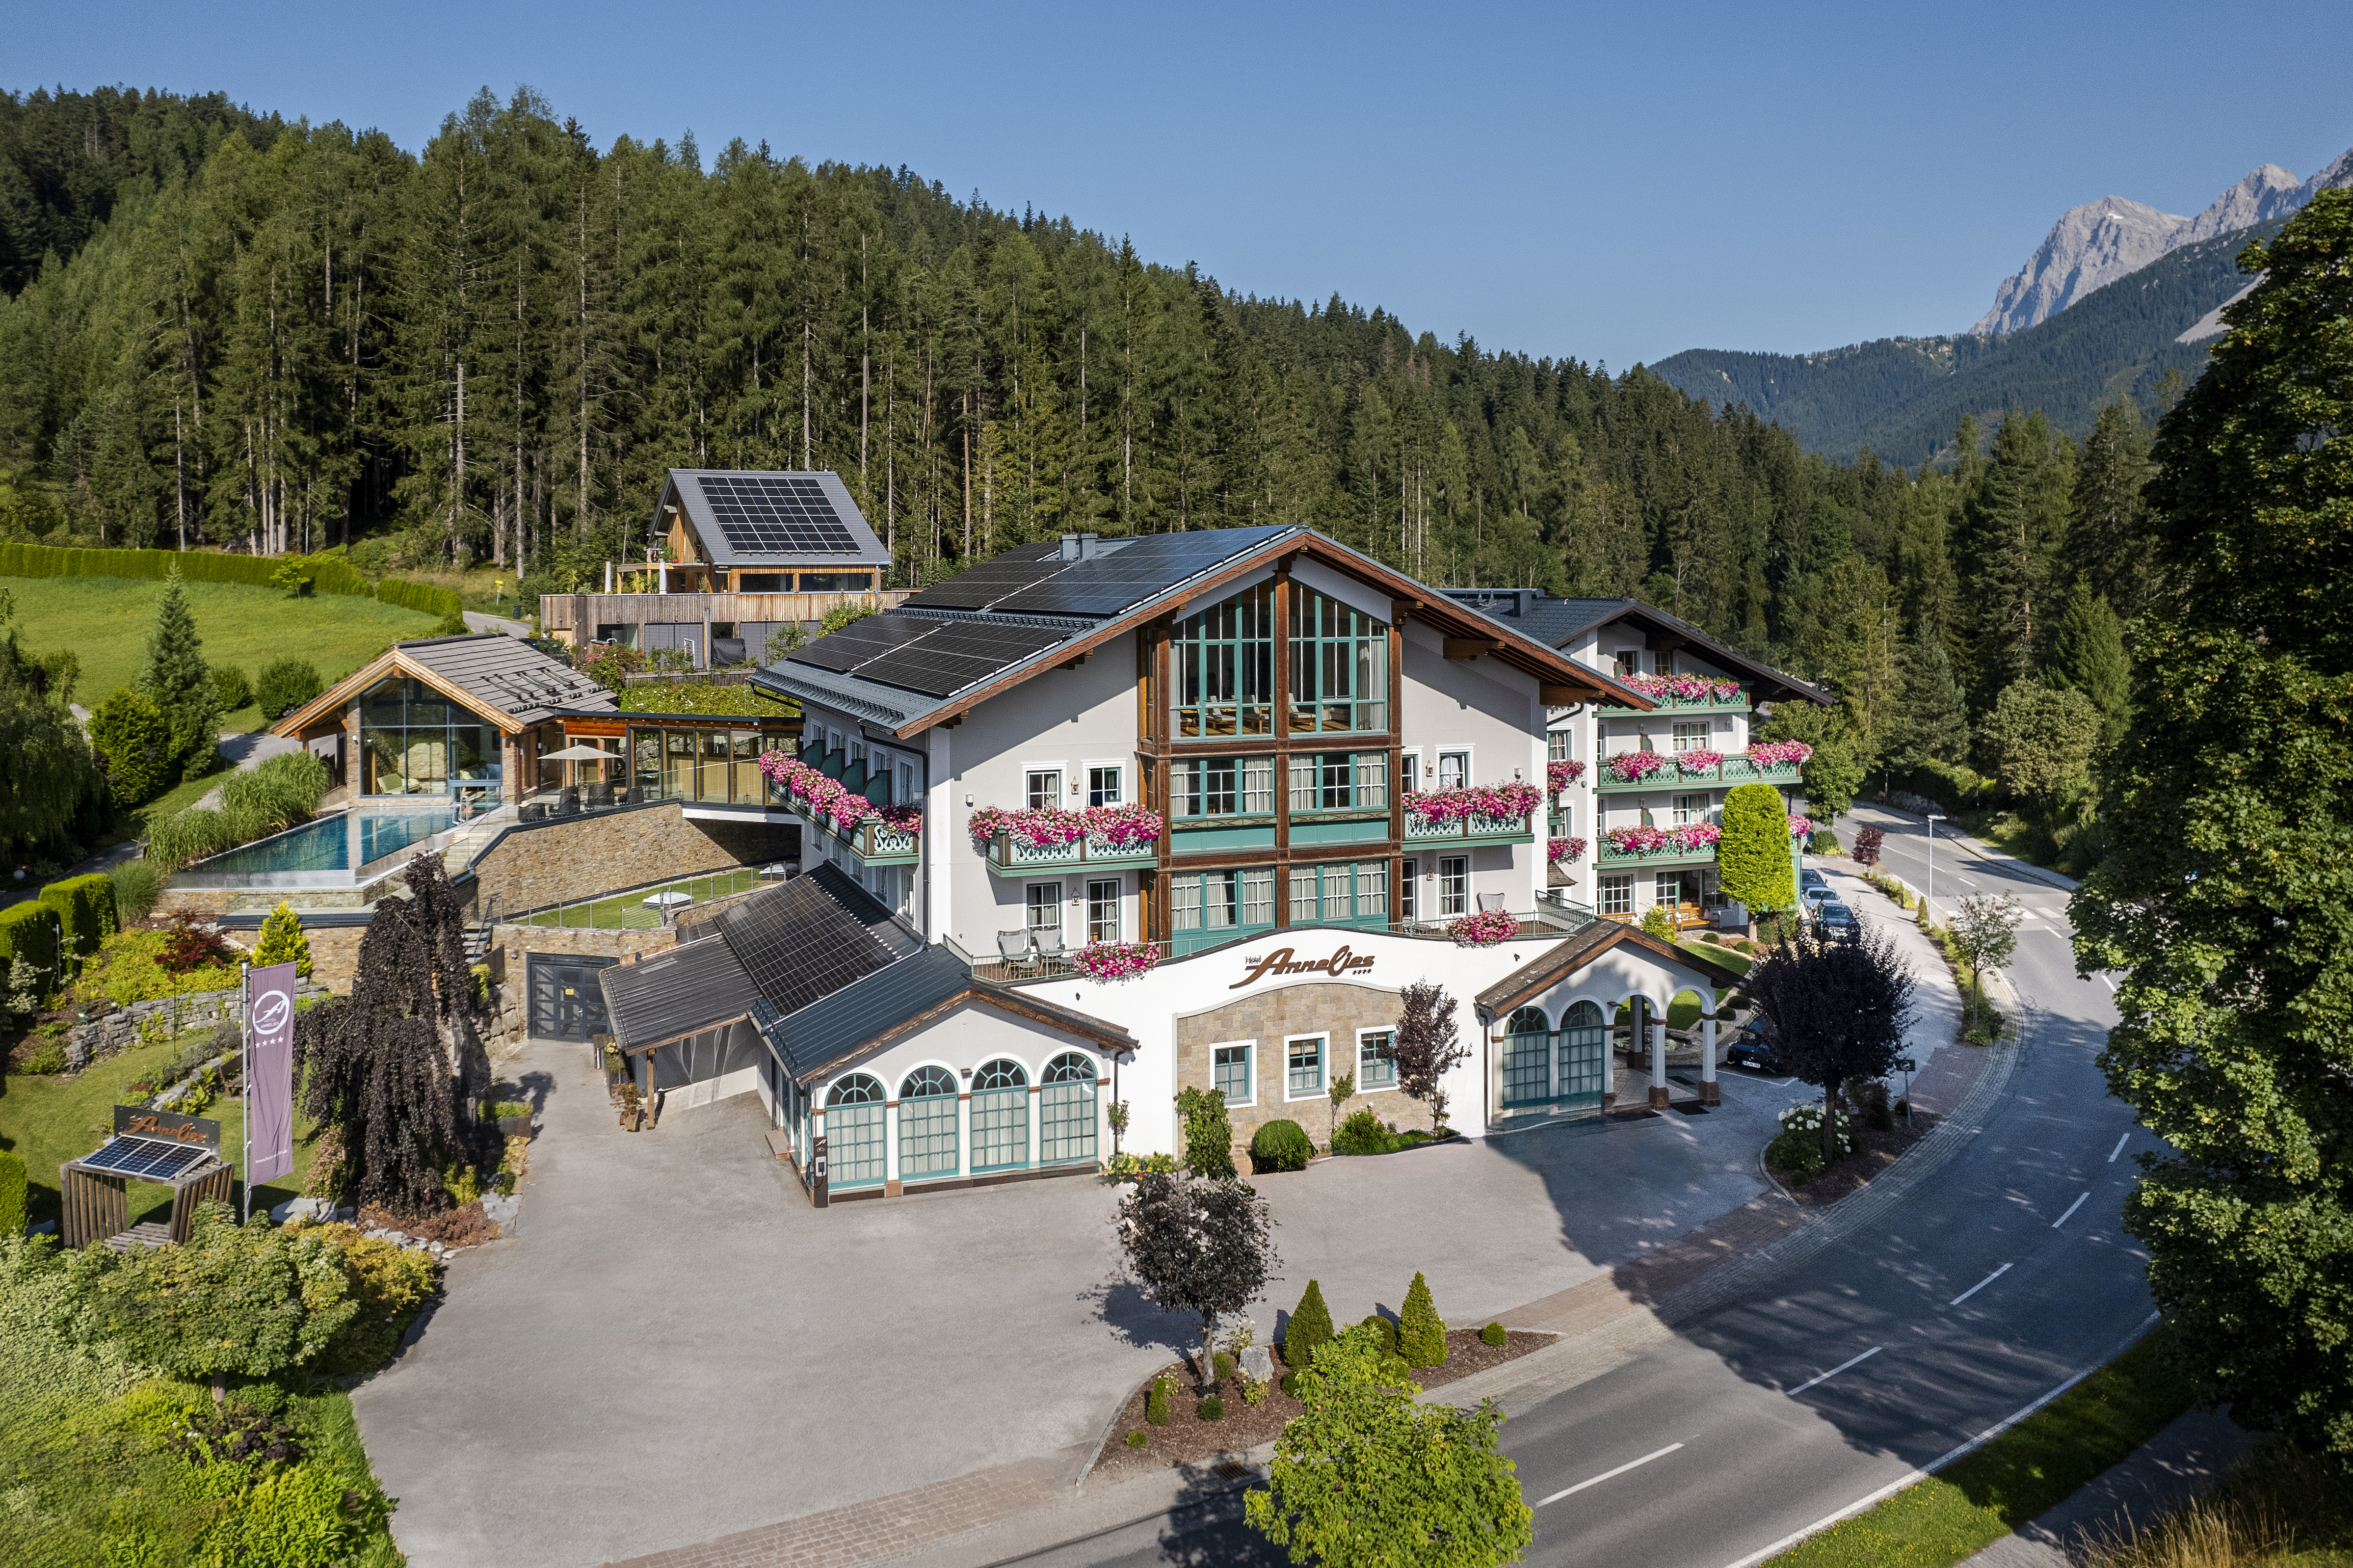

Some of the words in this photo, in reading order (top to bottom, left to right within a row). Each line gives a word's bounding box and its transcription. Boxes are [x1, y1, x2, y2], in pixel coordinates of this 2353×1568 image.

[1228, 945, 1375, 989] Annelies
[1245, 955, 1262, 965] Hotel
[122, 1115, 206, 1142] Annelies
